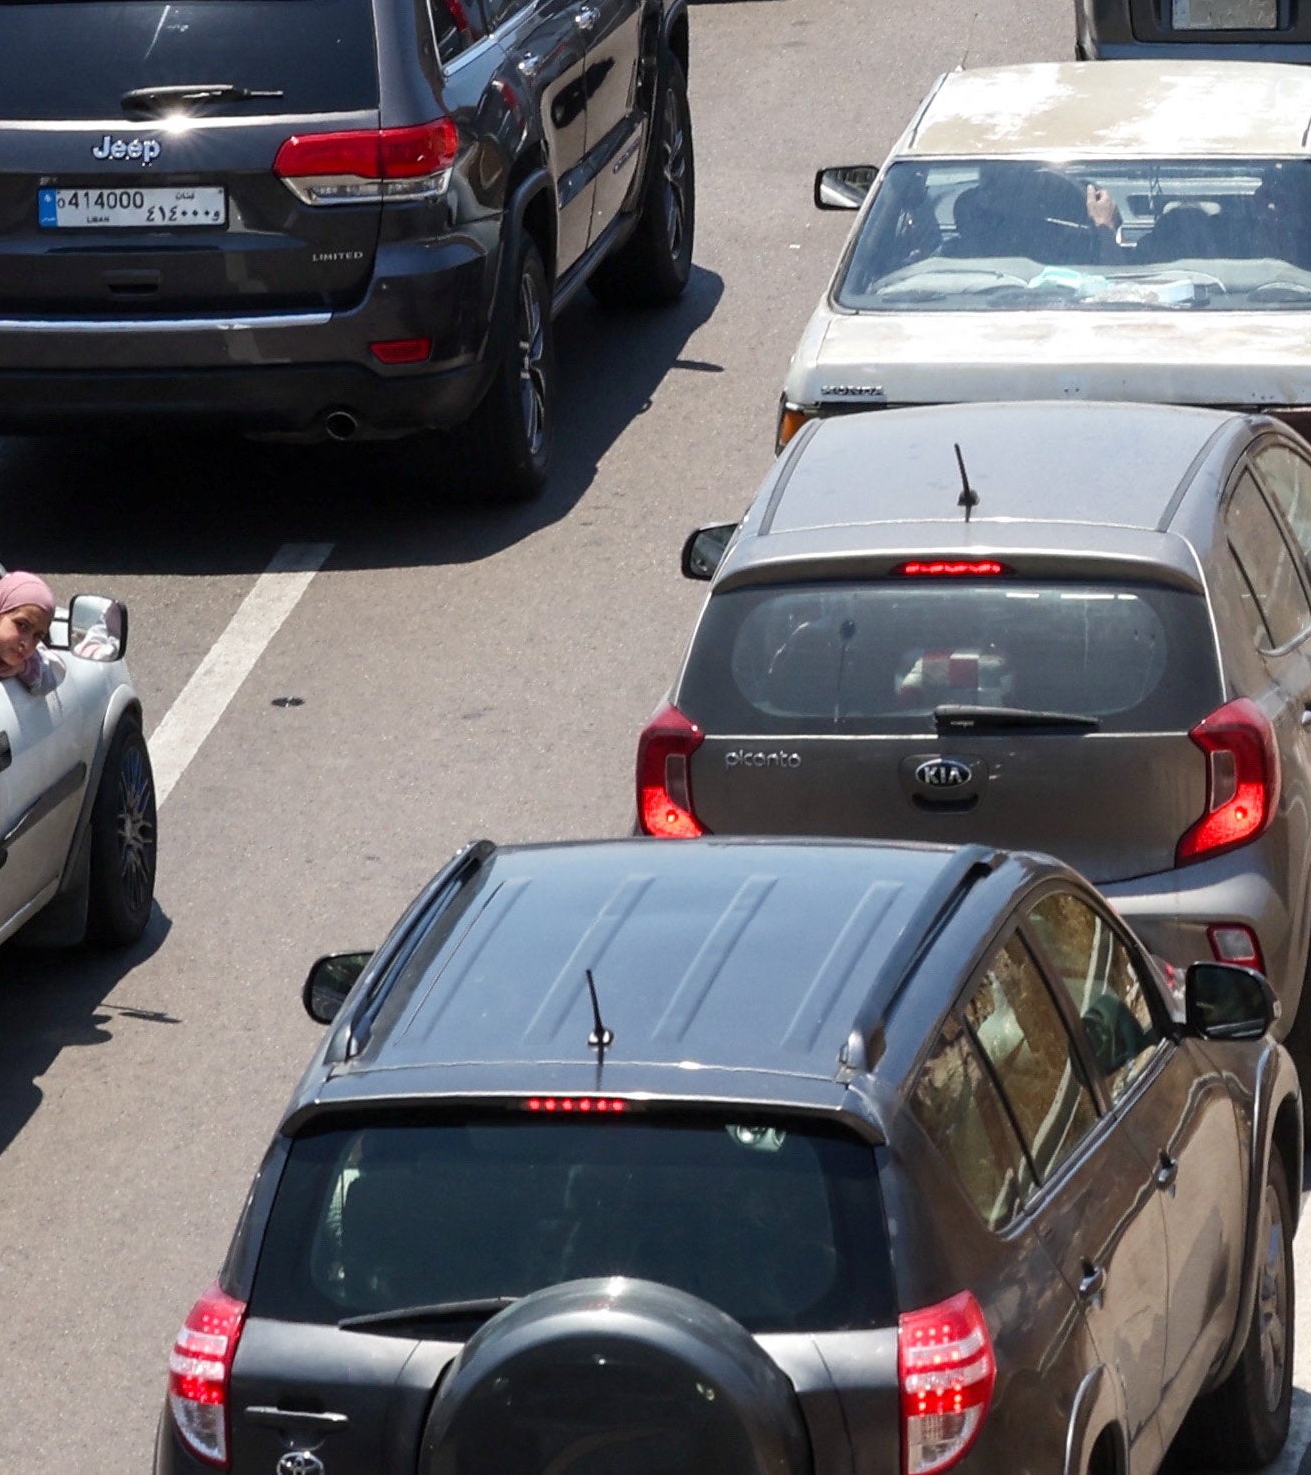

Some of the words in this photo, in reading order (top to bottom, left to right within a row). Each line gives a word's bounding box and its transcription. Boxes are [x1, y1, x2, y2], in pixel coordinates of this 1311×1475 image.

[92, 135, 161, 163] Jeep
[67, 191, 144, 212] 414000
[312, 251, 364, 262] LIMITED
[725, 749, 802, 769] picanto
[925, 766, 963, 783] KIA
